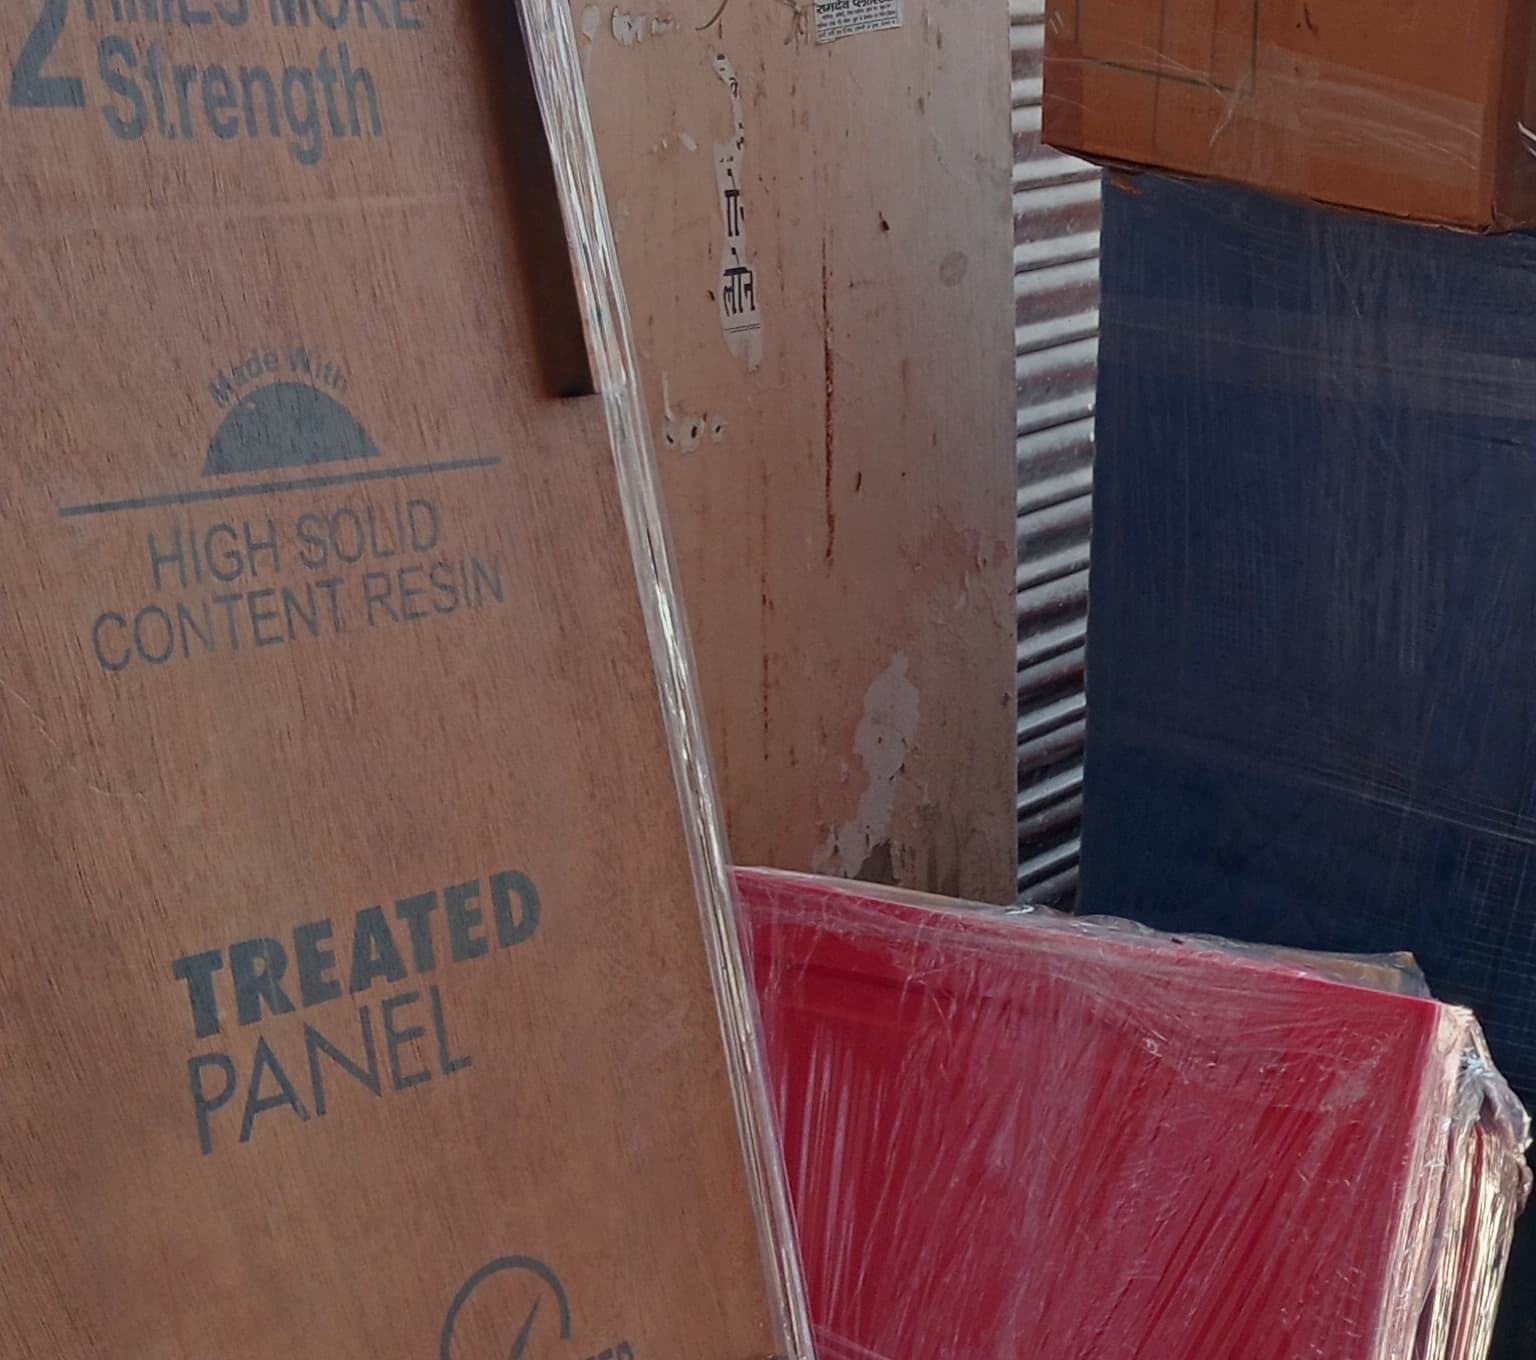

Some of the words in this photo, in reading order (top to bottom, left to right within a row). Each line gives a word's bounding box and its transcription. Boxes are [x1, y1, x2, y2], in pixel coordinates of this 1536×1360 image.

[100, 36, 382, 165] Strength
[207, 351, 279, 408] Made
[288, 345, 348, 396] With
[147, 517, 281, 591] HIGH
[295, 499, 441, 569] SOLID
[92, 578, 344, 672] CONTENT
[363, 557, 505, 627] RESIN
[173, 869, 542, 1038] TREATED
[188, 984, 473, 1155] PANEL
